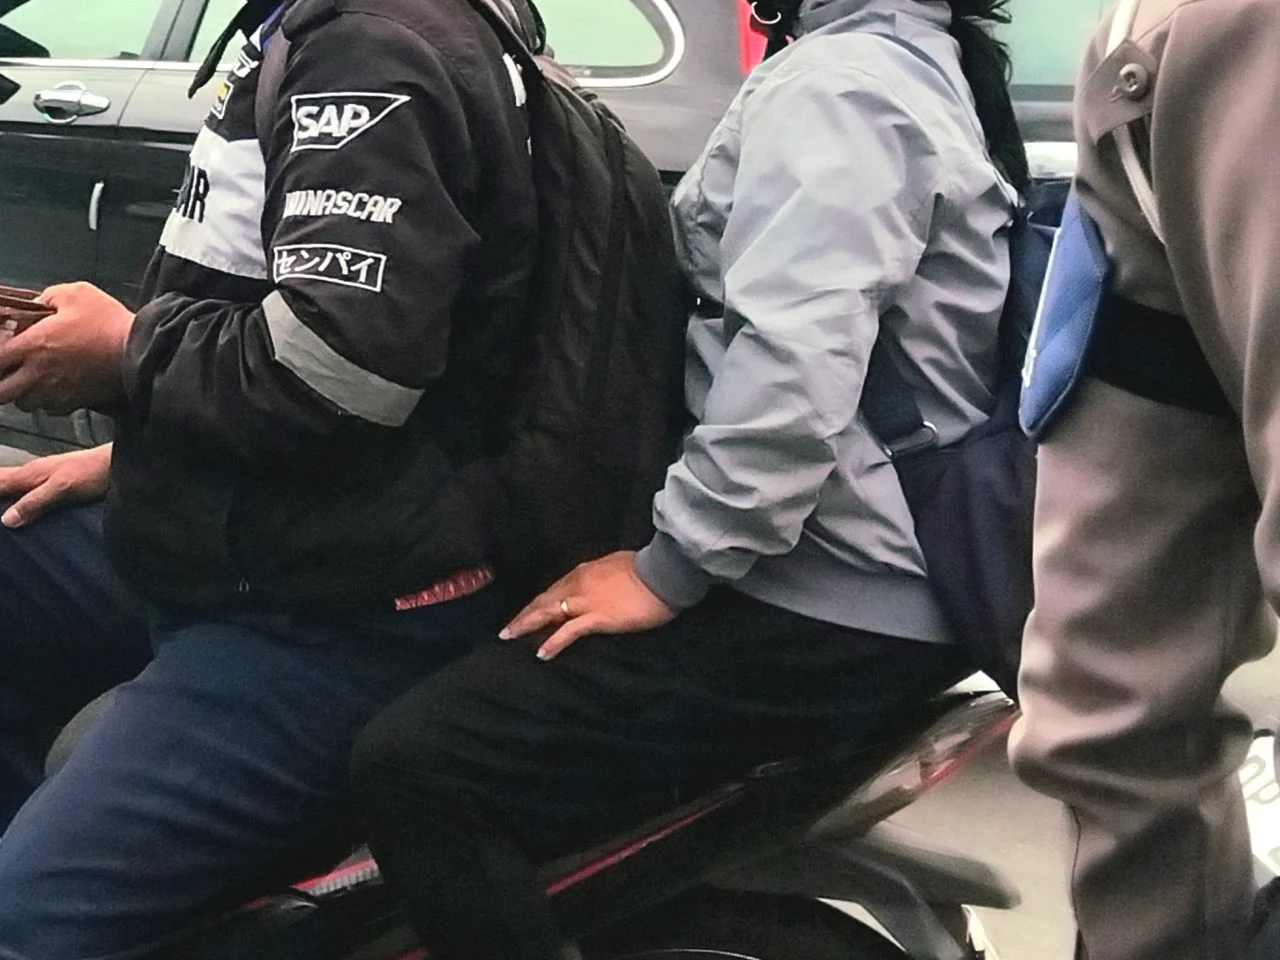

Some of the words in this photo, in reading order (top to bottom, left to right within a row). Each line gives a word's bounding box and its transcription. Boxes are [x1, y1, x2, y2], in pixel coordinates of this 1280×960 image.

[296, 104, 371, 140] SAP
[276, 249, 376, 283] センパイ
